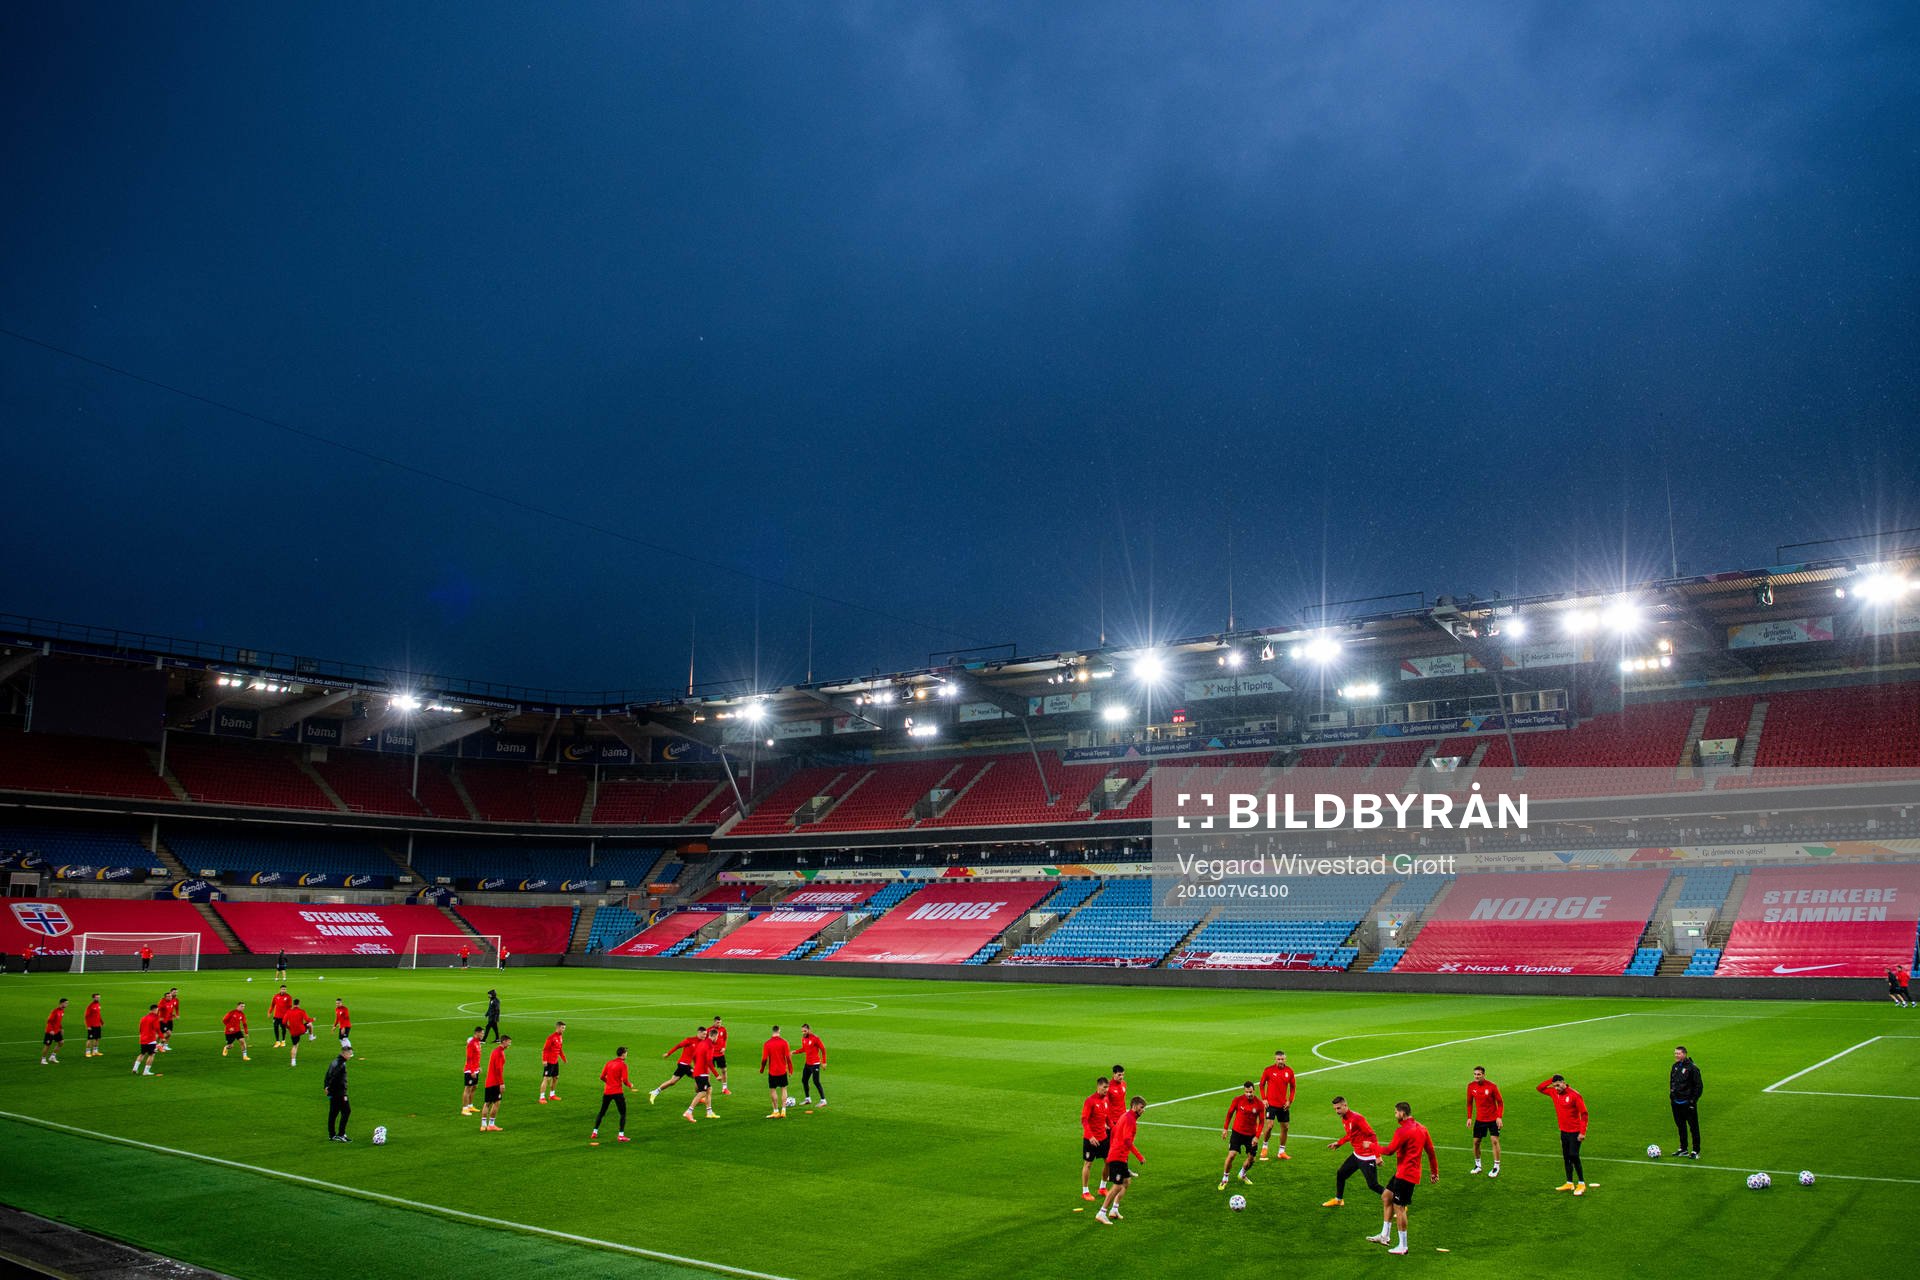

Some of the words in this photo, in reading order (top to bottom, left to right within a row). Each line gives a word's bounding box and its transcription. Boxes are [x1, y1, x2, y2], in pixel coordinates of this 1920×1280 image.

[1217, 683, 1241, 693] Norsk
[1243, 680, 1272, 692] Tipping
[221, 717, 252, 730] bama
[307, 725, 337, 739] bama
[386, 734, 414, 747] bama
[496, 742, 527, 753] bama
[602, 746, 628, 758] bama
[1502, 855, 1525, 864] Tipping
[105, 867, 131, 880] Bendit
[259, 871, 281, 885] Bendit
[306, 874, 327, 887] Bendit
[351, 875, 372, 888] Bendit
[485, 879, 505, 890] Bendit
[526, 881, 547, 892] Bendit
[182, 880, 207, 895] Bendit
[425, 887, 446, 898] Bendit
[792, 892, 863, 902] STERKERE
[1763, 888, 1898, 904] STERKERE
[905, 901, 1008, 921] NORGE
[1468, 896, 1612, 920] NORGE
[1763, 906, 1887, 922] SAMMEN
[299, 910, 384, 924] STERKERE
[763, 911, 829, 922] SAMMEN
[316, 925, 393, 937] SAMMEN
[1464, 964, 1510, 972] Norsk
[1514, 964, 1575, 973] Tipping
